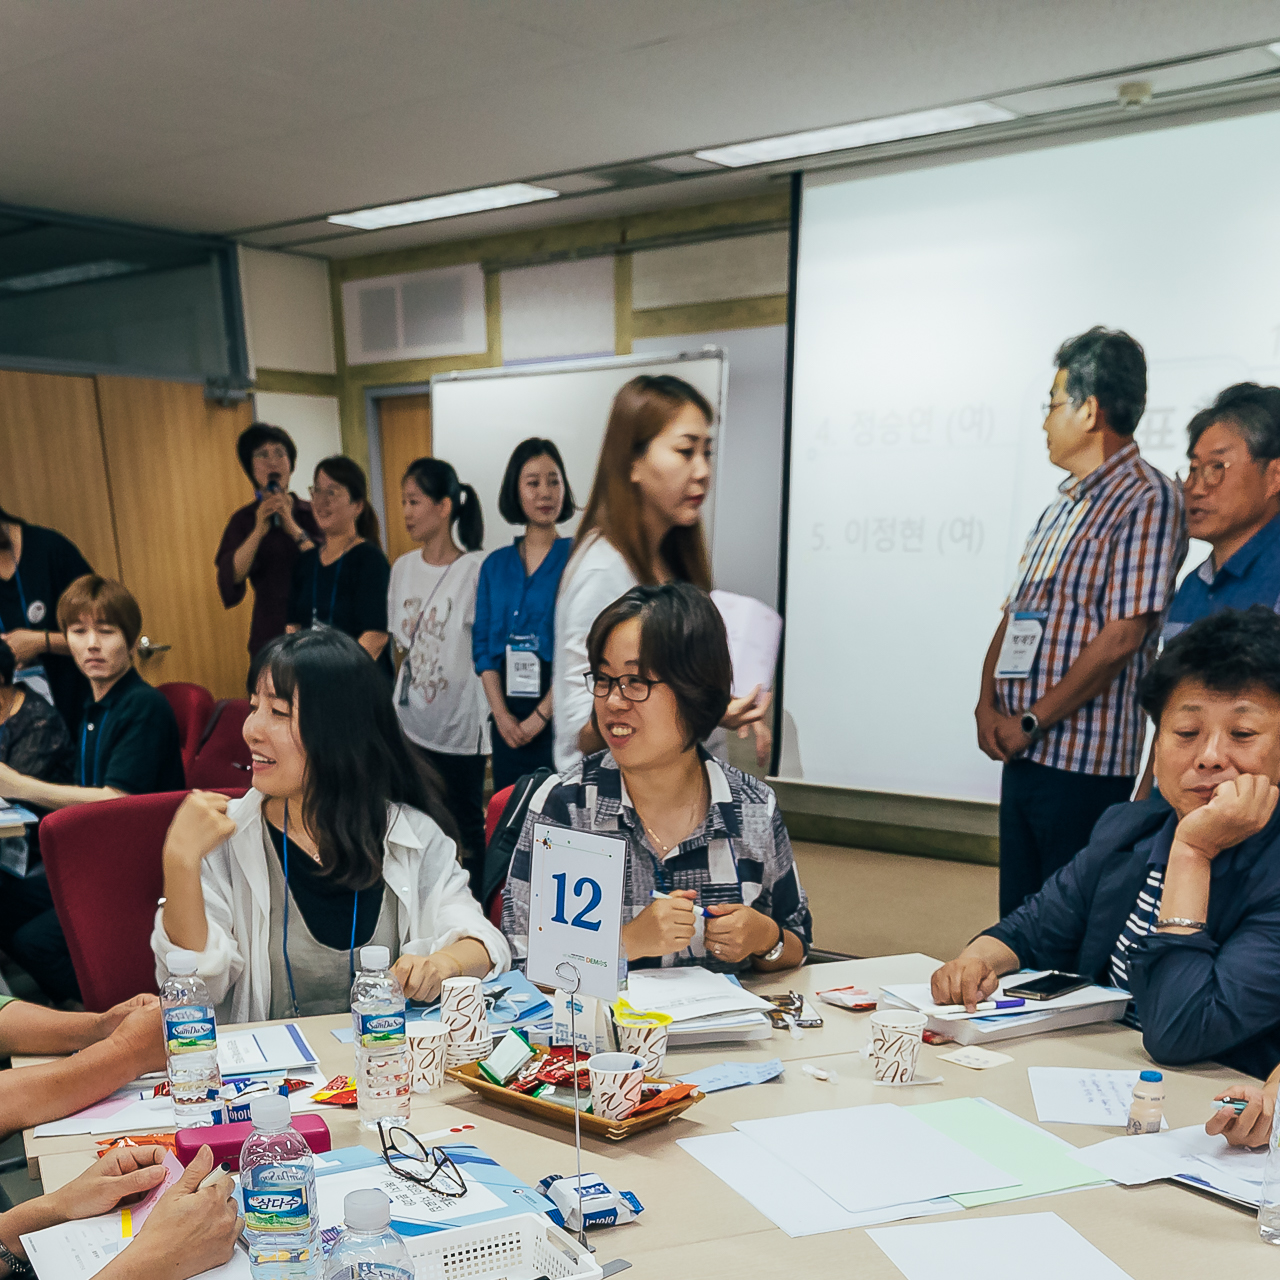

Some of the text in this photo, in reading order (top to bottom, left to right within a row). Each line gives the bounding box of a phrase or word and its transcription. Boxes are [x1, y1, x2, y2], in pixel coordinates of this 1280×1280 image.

[851, 406, 934, 447] 정승연
[946, 402, 995, 445] (여)
[844, 516, 925, 554] 이정현
[936, 514, 986, 556] (여)
[551, 873, 602, 932] 12
[173, 1022, 212, 1037] SamDaSoo
[257, 1196, 300, 1211] 삼다수
